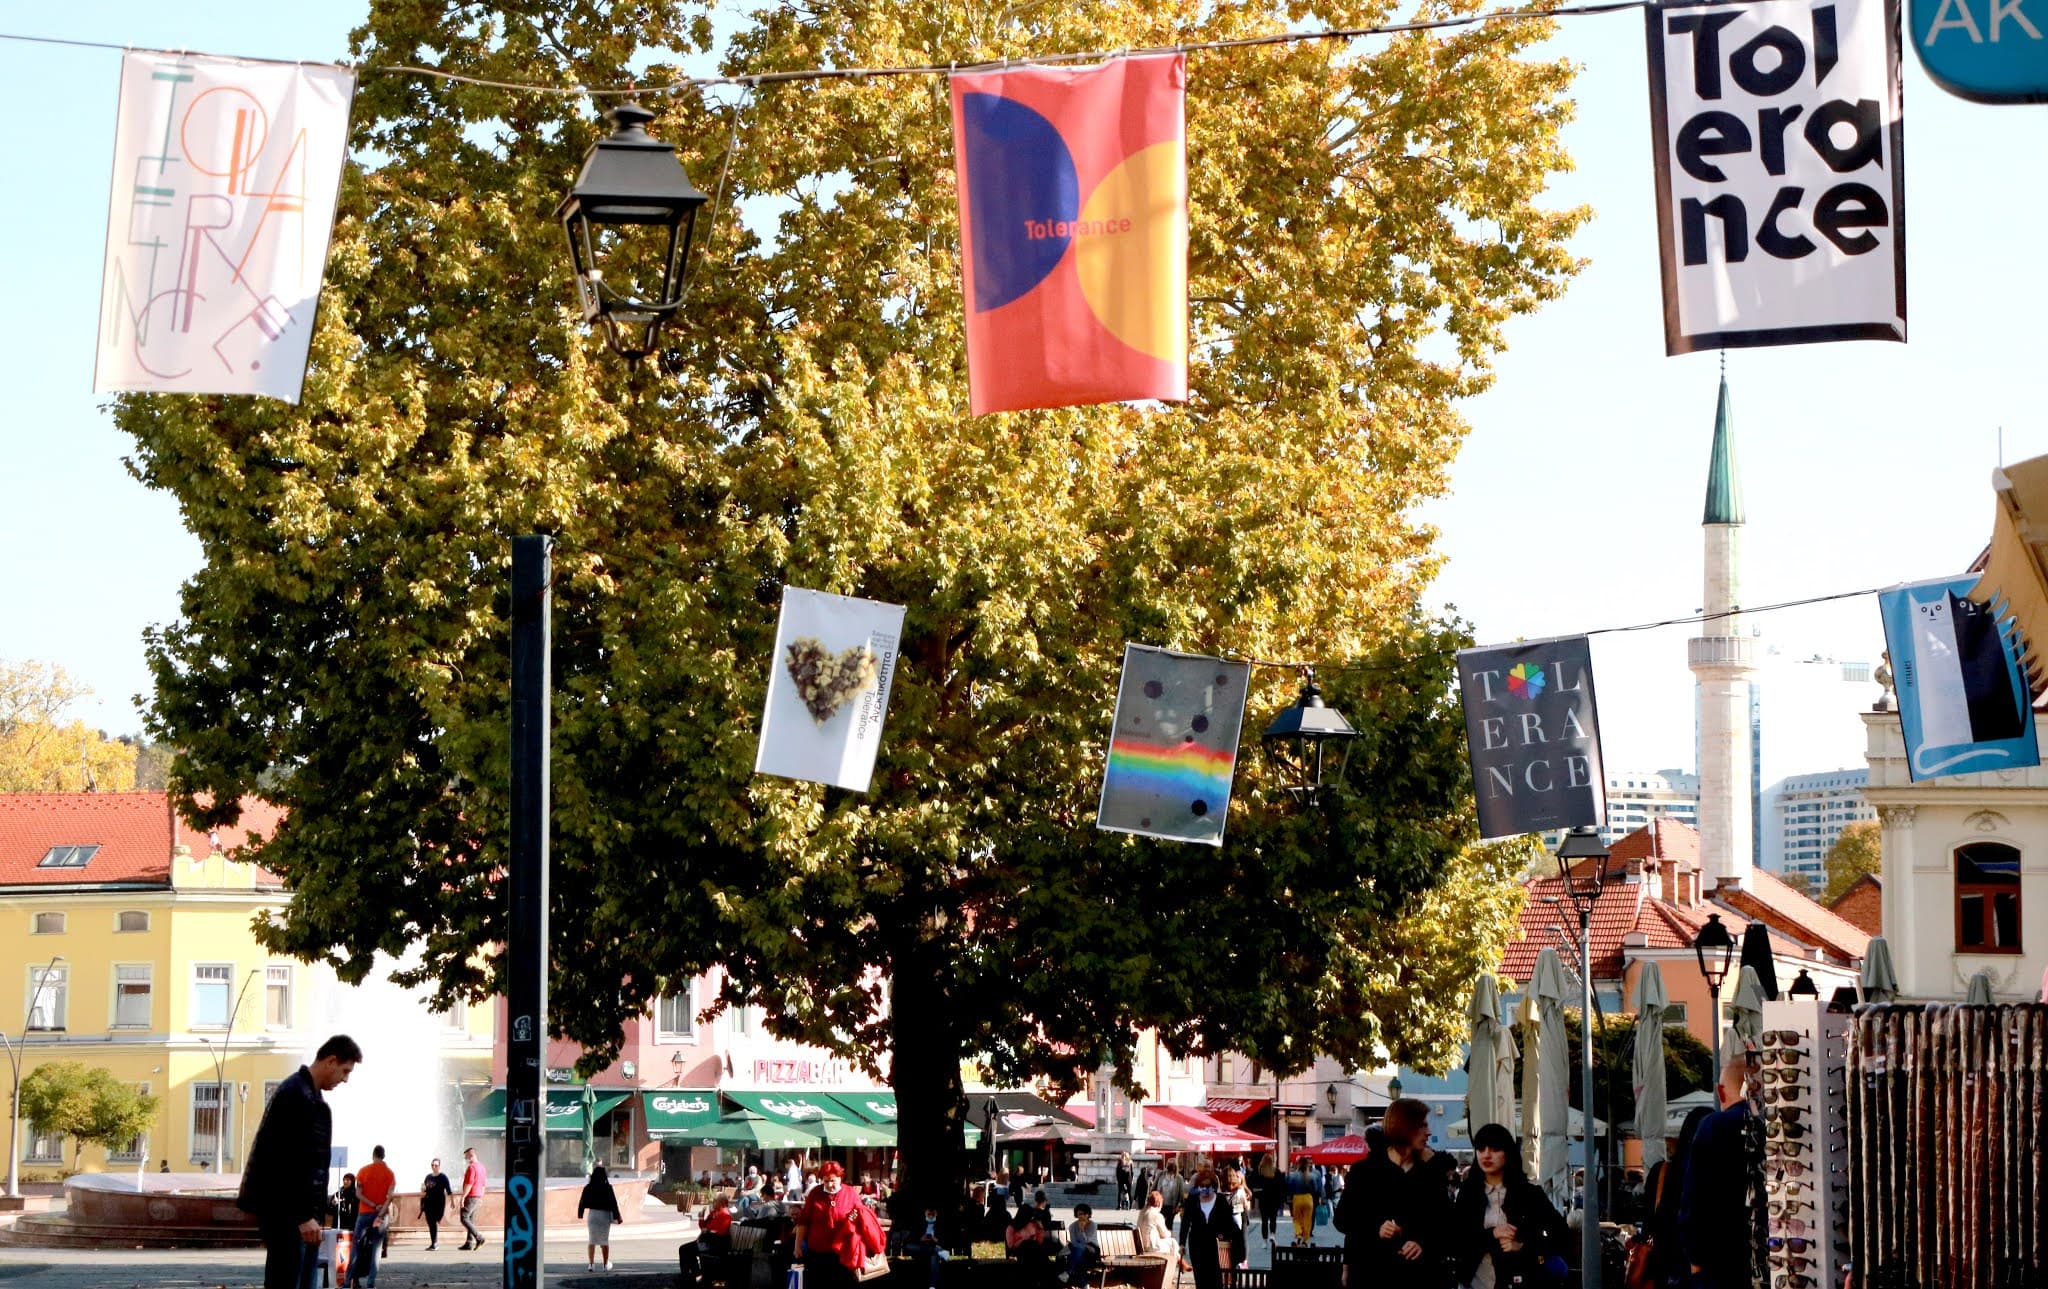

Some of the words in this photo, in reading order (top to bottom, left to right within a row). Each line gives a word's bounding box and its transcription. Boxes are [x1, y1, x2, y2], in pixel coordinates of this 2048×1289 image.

[1667, 4, 1839, 101] Tol
[1676, 98, 1884, 183] era
[1024, 218, 1131, 241] Tolerance
[1680, 182, 1889, 267] nce
[857, 689, 877, 741] Tolerance
[1479, 707, 1590, 751] ERA
[1485, 755, 1594, 798] NCE
[652, 1096, 710, 1115] Carlsberg
